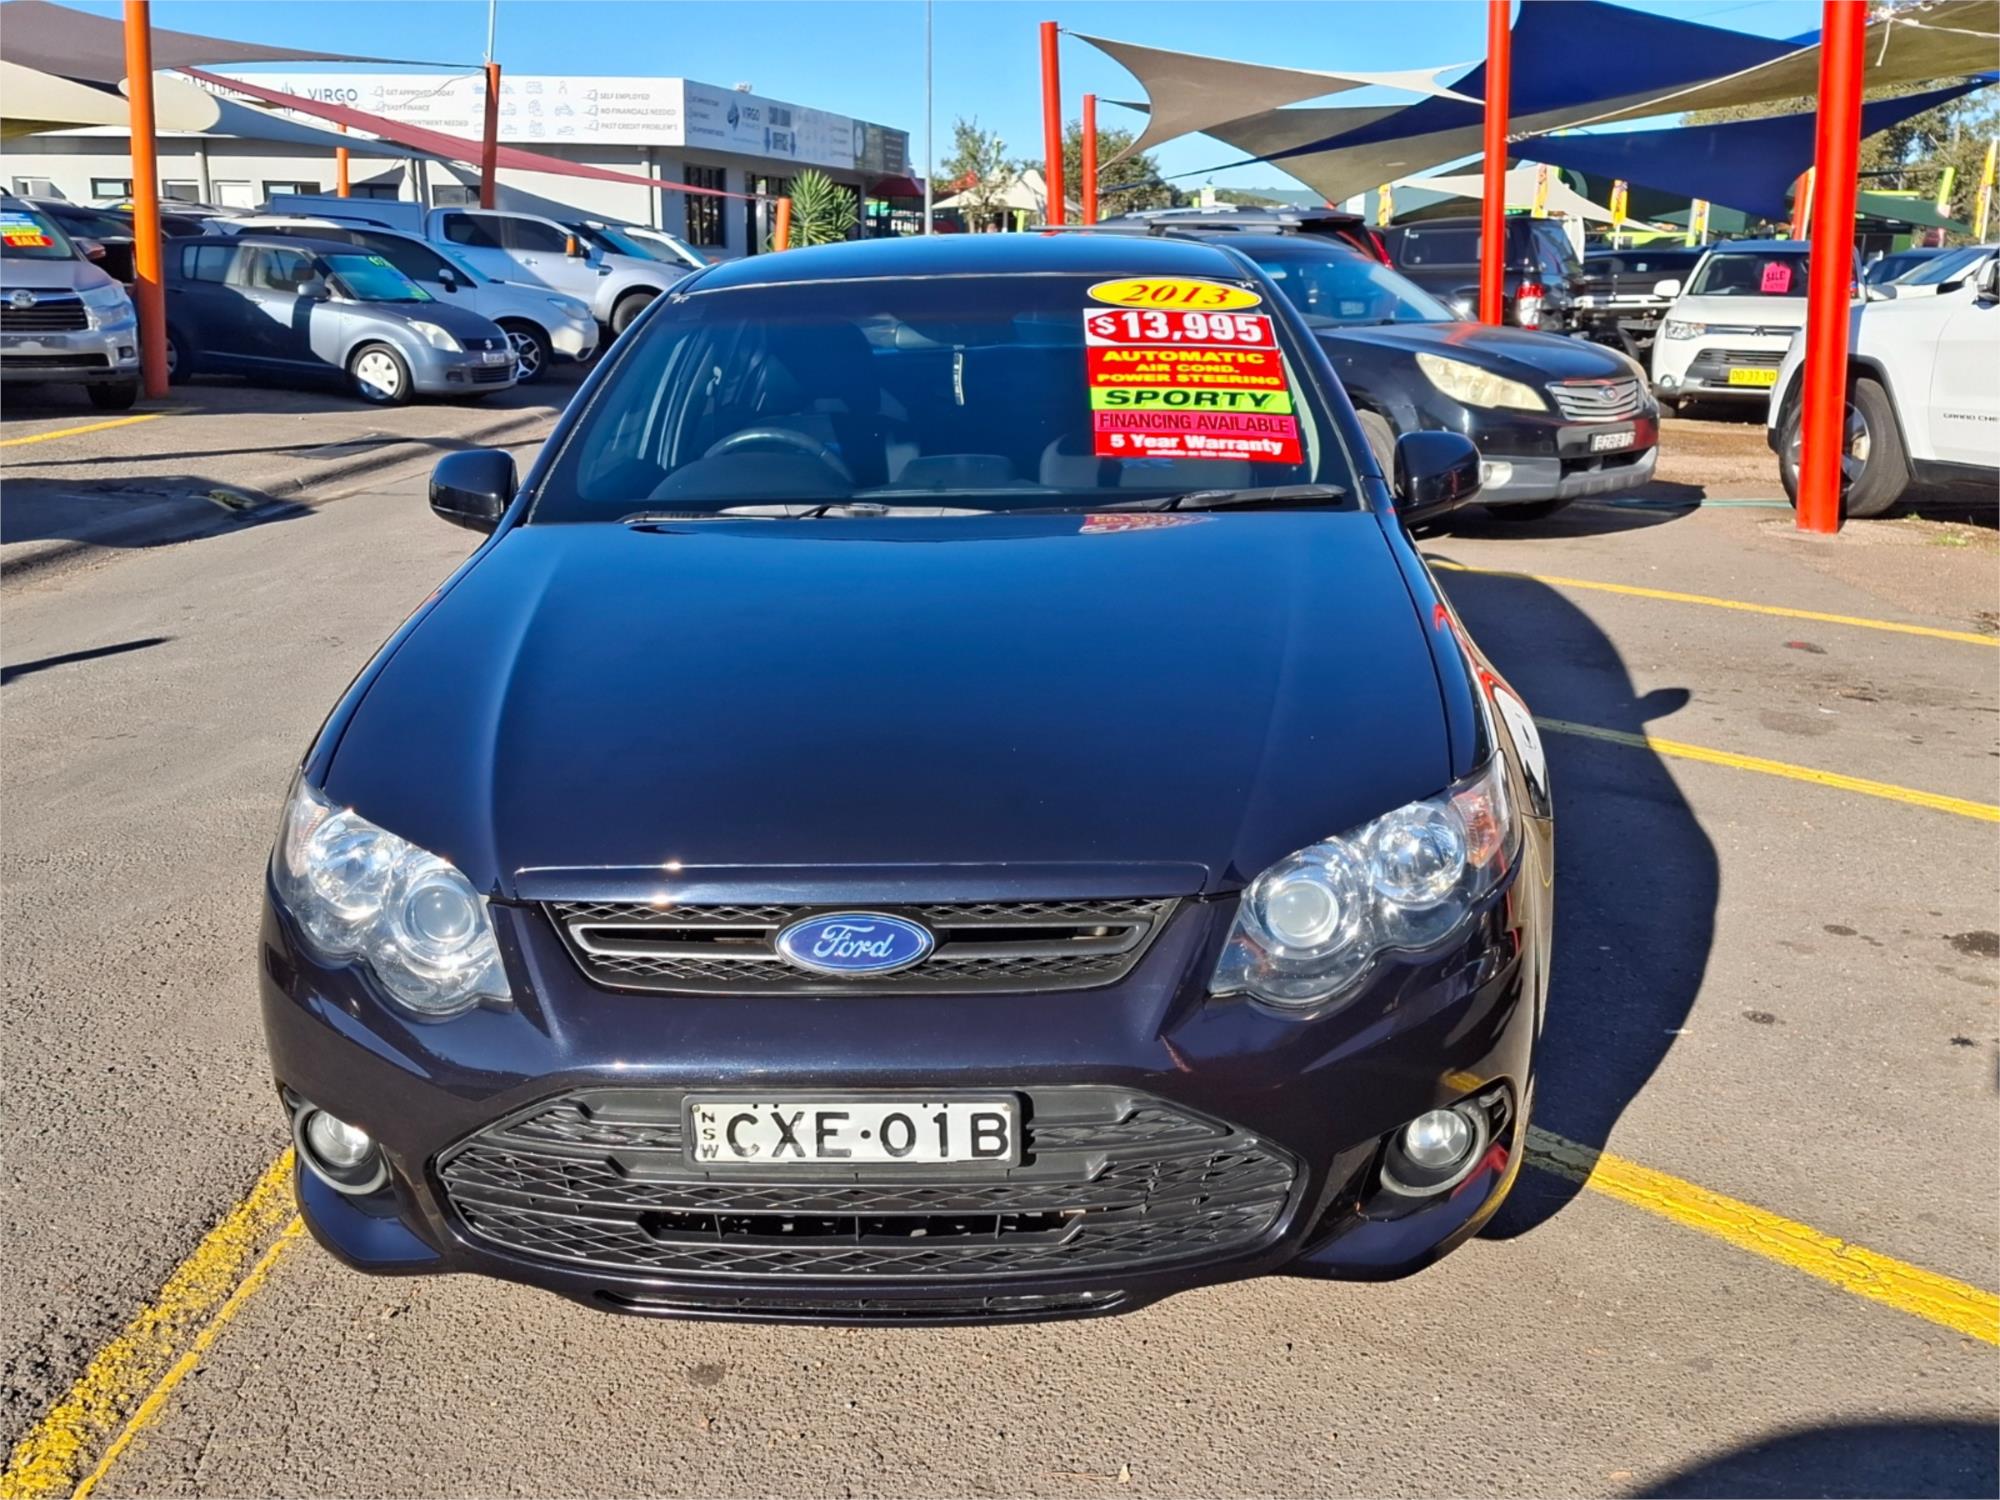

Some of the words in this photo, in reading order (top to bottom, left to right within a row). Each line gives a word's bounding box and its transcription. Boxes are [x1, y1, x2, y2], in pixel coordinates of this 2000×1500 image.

[308, 88, 358, 102] VIRGO
[399, 89, 432, 97] APPROVED
[650, 108, 677, 116] NEEDED
[444, 119, 469, 127] NEEDED
[11, 236, 47, 246] SALE
[1120, 283, 1231, 304] 2013
[1095, 311, 1263, 343] $13,995
[1103, 351, 1265, 364] AUTOMATIC
[1136, 364, 1171, 372] AIR
[1177, 364, 1240, 373] COND.
[1097, 374, 1172, 383] POWER
[1177, 374, 1280, 386] STEERING
[1105, 390, 1273, 408] SPORTY
[1100, 413, 1192, 430] FINANCING
[1196, 416, 1290, 434] AVAILABLE
[1110, 434, 1125, 448] 5
[1131, 434, 1179, 449] Year
[1184, 435, 1283, 455] Warranty
[812, 924, 895, 958] Ford
